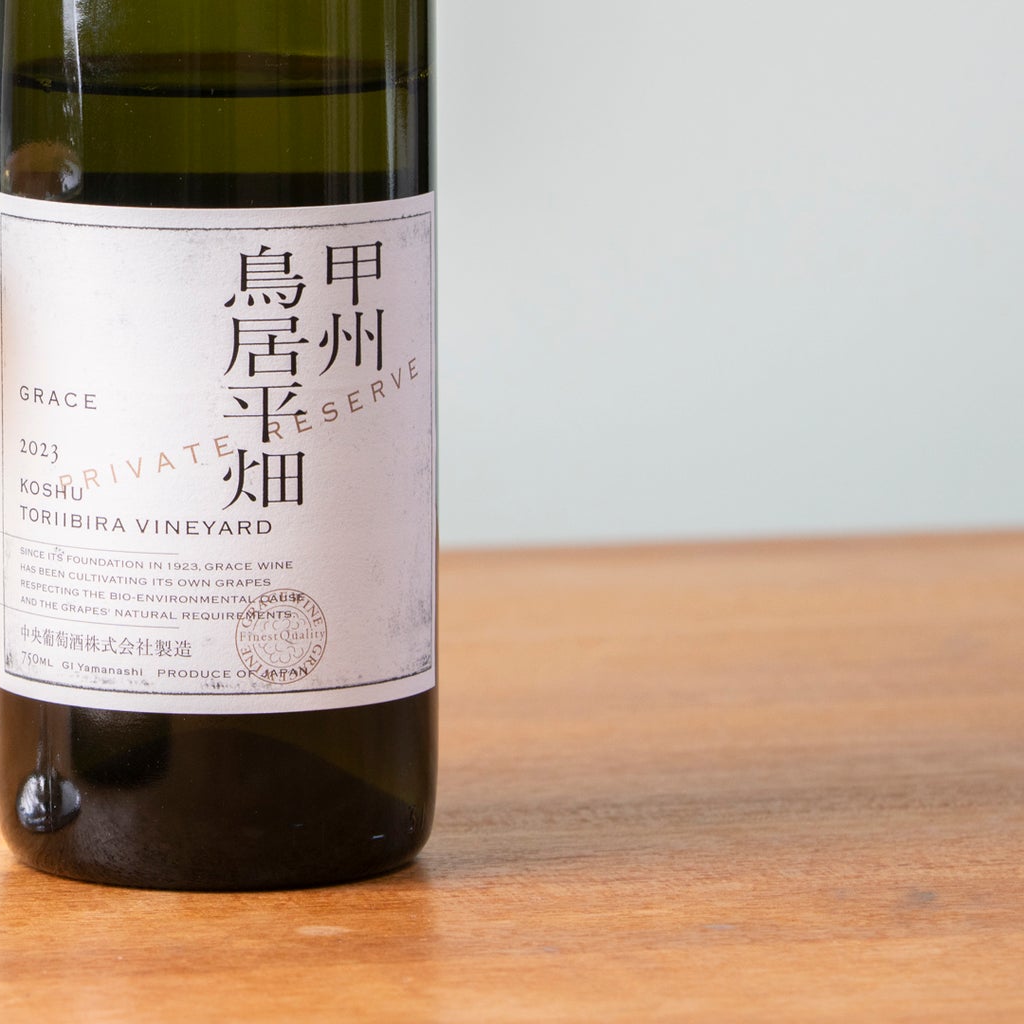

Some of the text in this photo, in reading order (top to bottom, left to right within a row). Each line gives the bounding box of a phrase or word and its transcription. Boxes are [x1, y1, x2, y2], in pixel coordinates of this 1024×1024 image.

[319, 240, 384, 376] 甲州
[222, 245, 310, 511] 鳥居平畑
[19, 385, 97, 410] GRACE
[59, 357, 419, 494] PRIVATE RESERVE
[19, 438, 59, 464] 2023
[19, 478, 83, 502] KOSHU
[19, 505, 273, 536] TORIIBIRA VINEYARD
[20, 546, 294, 572] SINCE ITS FOUNDATION IN 1923, GRACE WINE
[20, 563, 272, 588] HAS BEEN CULTIVATING ITS OWN GRAPES
[20, 579, 305, 605] RESPECTING THE BIO-ENVIRONMENTAL CAUSE
[20, 595, 296, 622] AND THE GRAPES' NATURAL REQUIREMENTS.
[20, 624, 193, 658] 中央葡萄酒株式会社製造
[239, 628, 326, 645] Finest Quality
[21, 650, 309, 679] 750ML GI Yamanashi PRODUCE OF JAPAN
